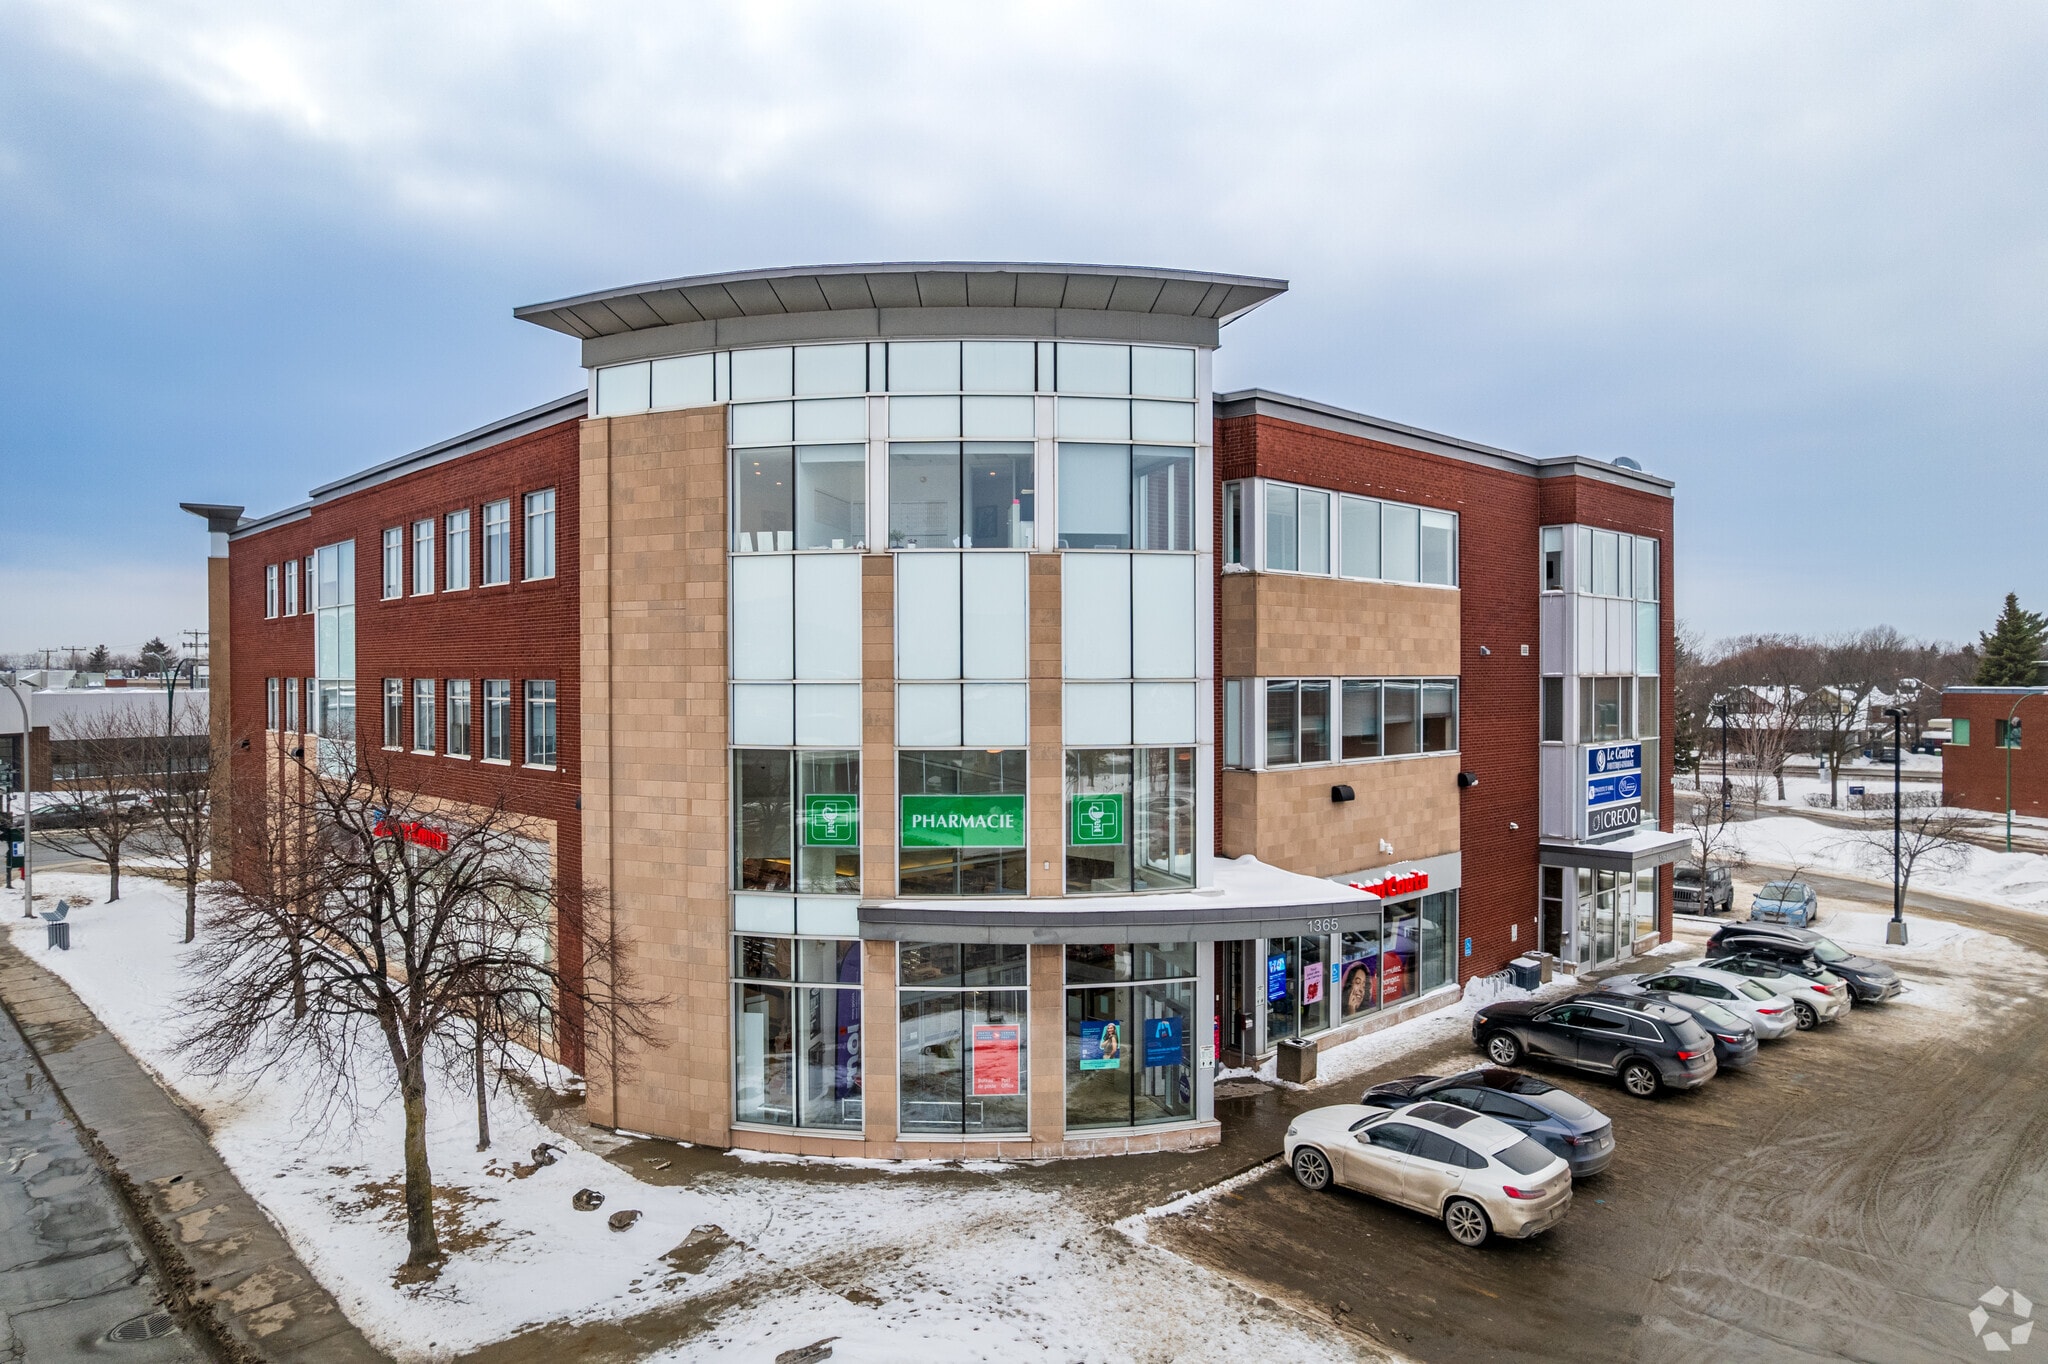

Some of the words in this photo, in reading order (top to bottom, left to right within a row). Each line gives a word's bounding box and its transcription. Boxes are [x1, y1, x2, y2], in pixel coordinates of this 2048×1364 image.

[1607, 748, 1614, 760] Le
[1615, 747, 1634, 759] Centre
[912, 814, 1014, 828] PHARMACIE
[1604, 806, 1638, 828] CREOQ
[1384, 871, 1428, 896] Coutu
[1307, 918, 1338, 932] 1365
